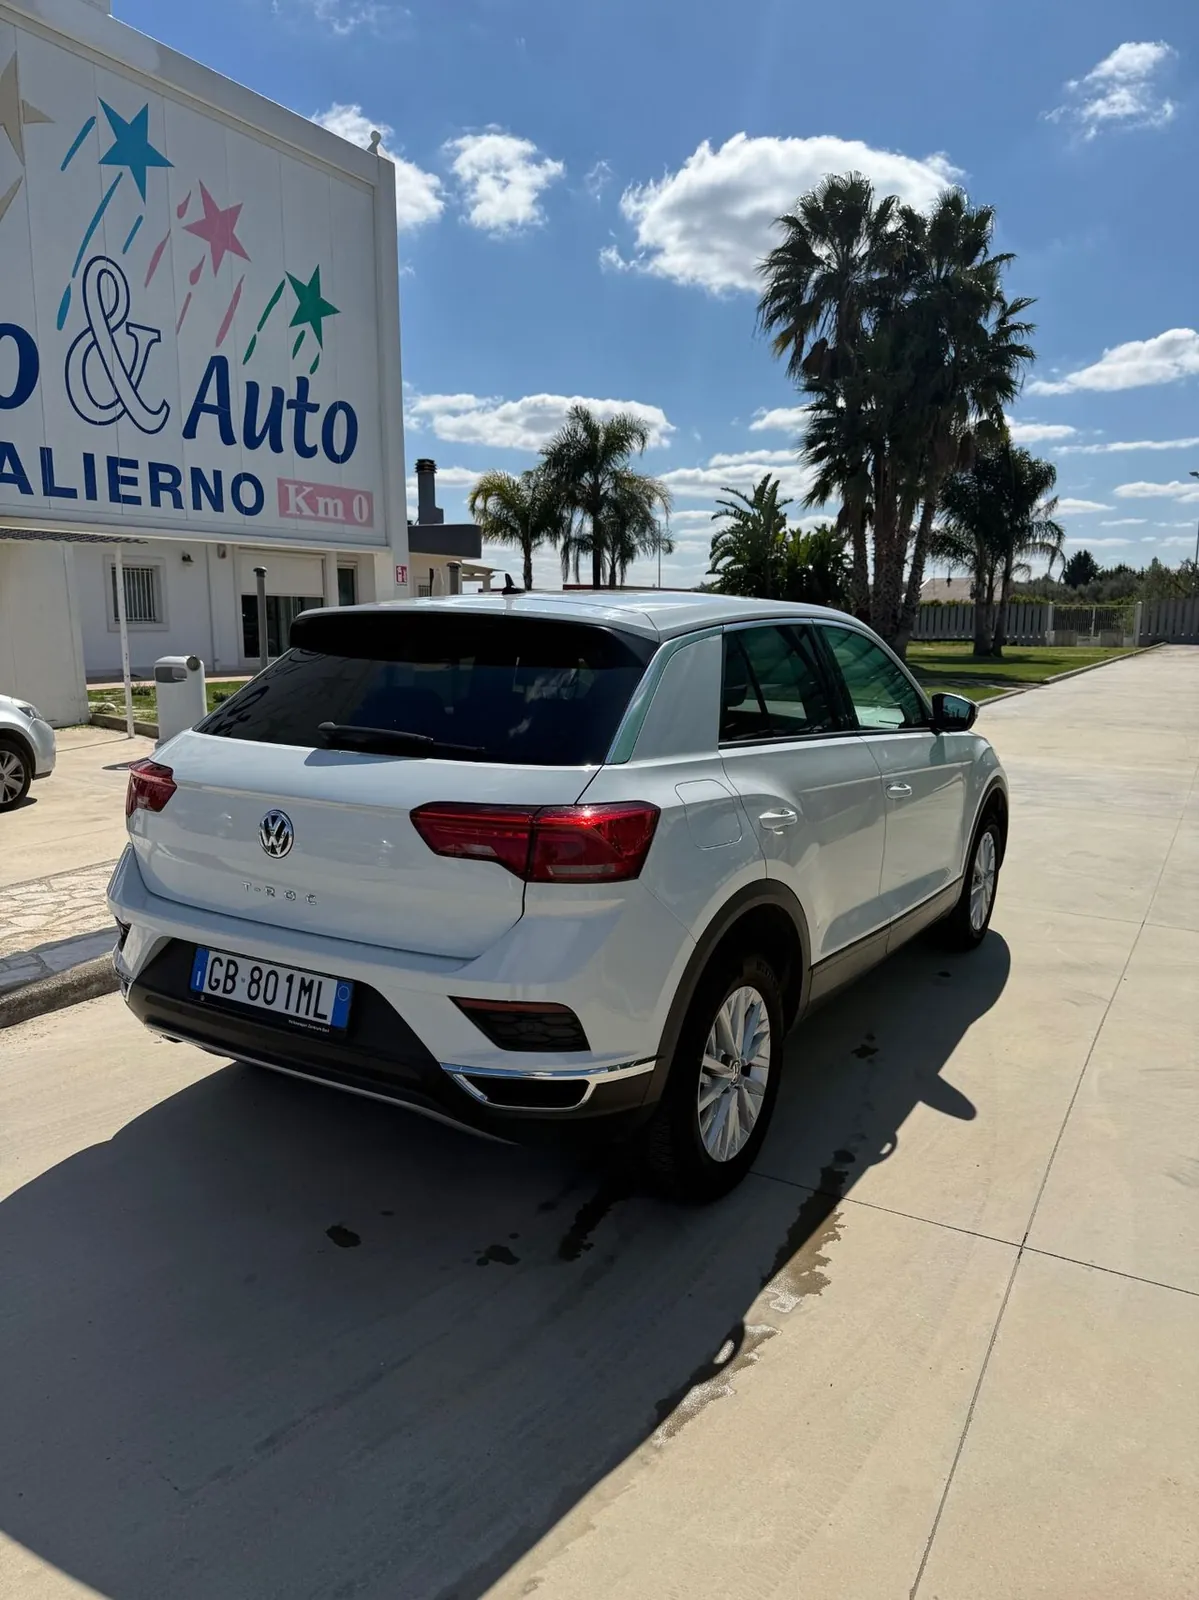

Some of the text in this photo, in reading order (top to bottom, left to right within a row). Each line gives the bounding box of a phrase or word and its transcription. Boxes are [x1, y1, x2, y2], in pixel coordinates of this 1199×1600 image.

[65, 255, 169, 434] &
[182, 355, 358, 464] Auto
[0, 441, 265, 516] ALIERNO
[285, 483, 346, 520] Km
